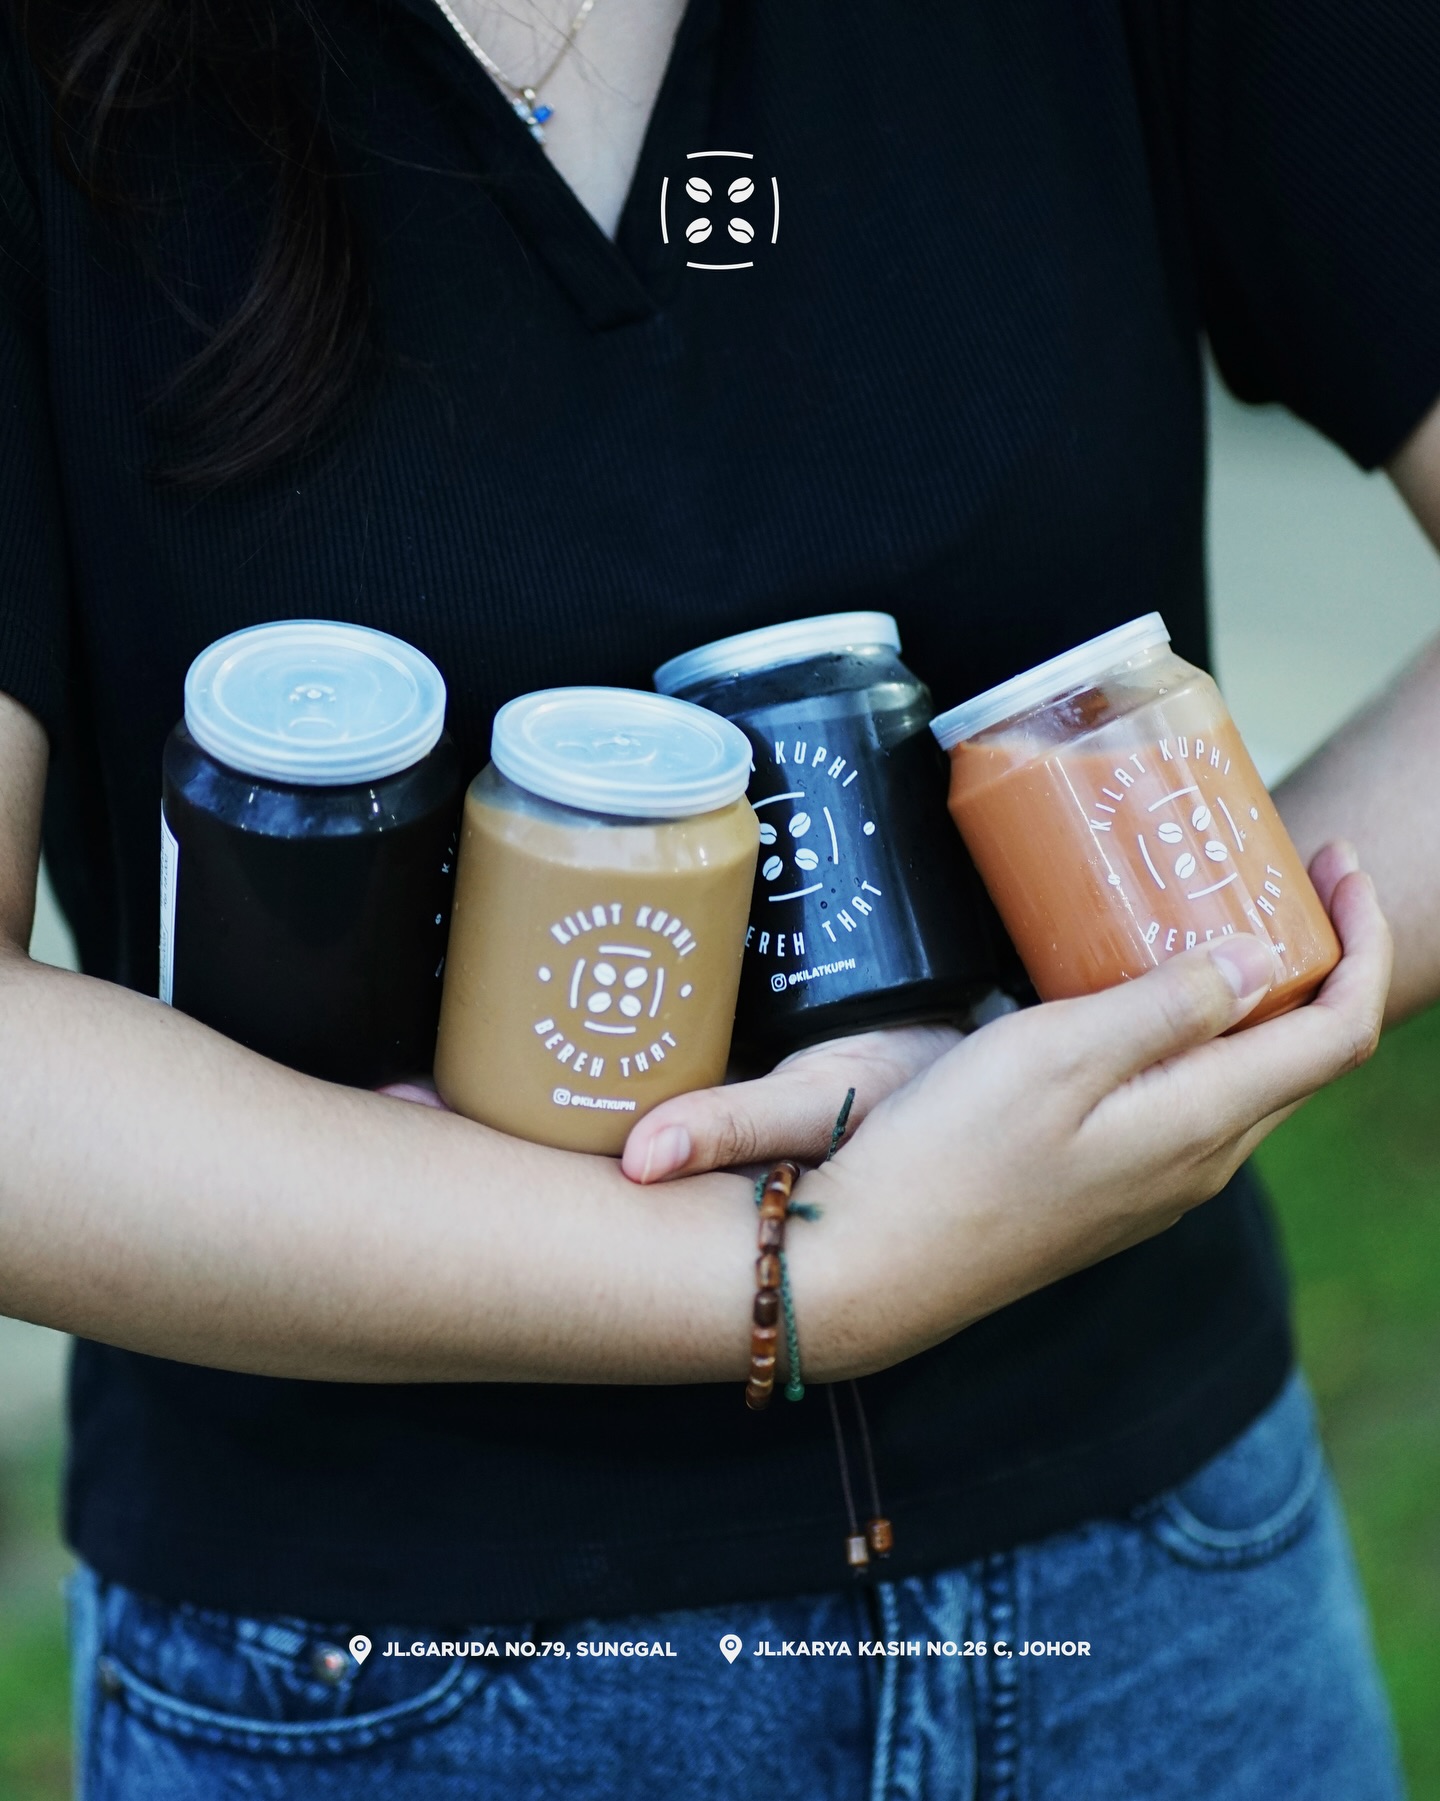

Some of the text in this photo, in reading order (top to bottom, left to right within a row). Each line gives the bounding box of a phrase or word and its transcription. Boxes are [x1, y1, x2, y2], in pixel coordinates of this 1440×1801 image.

[774, 740, 858, 787] KUPHI
[1090, 736, 1231, 832] KILAT KUPHI
[551, 903, 697, 957] KILAT KUPHI
[745, 880, 882, 958] EREH THAT
[788, 864, 1283, 985] @KILATKUPHI THAT
[535, 1018, 677, 1078] BEREH THAT
[571, 1094, 636, 1112] @KILATKUPHI
